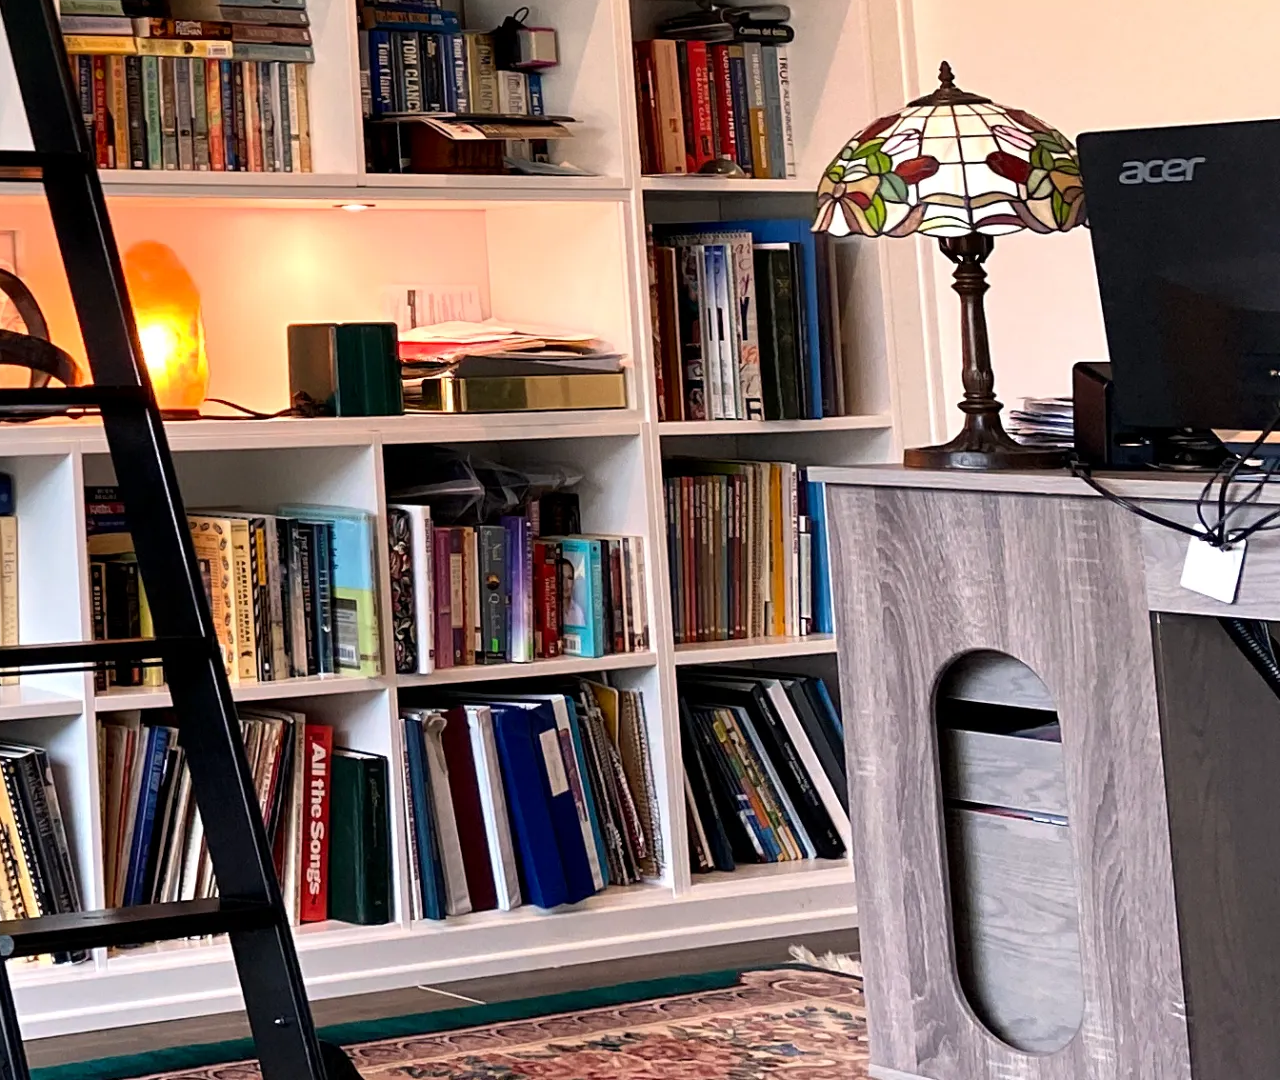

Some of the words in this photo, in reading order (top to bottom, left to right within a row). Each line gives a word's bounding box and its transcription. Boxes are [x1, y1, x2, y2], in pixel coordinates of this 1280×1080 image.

[402, 39, 417, 65] TOM
[779, 57, 791, 85] TRUE
[1119, 157, 1206, 184] acer
[310, 742, 327, 776] All
[309, 778, 327, 819] the
[306, 820, 326, 896] Songs
